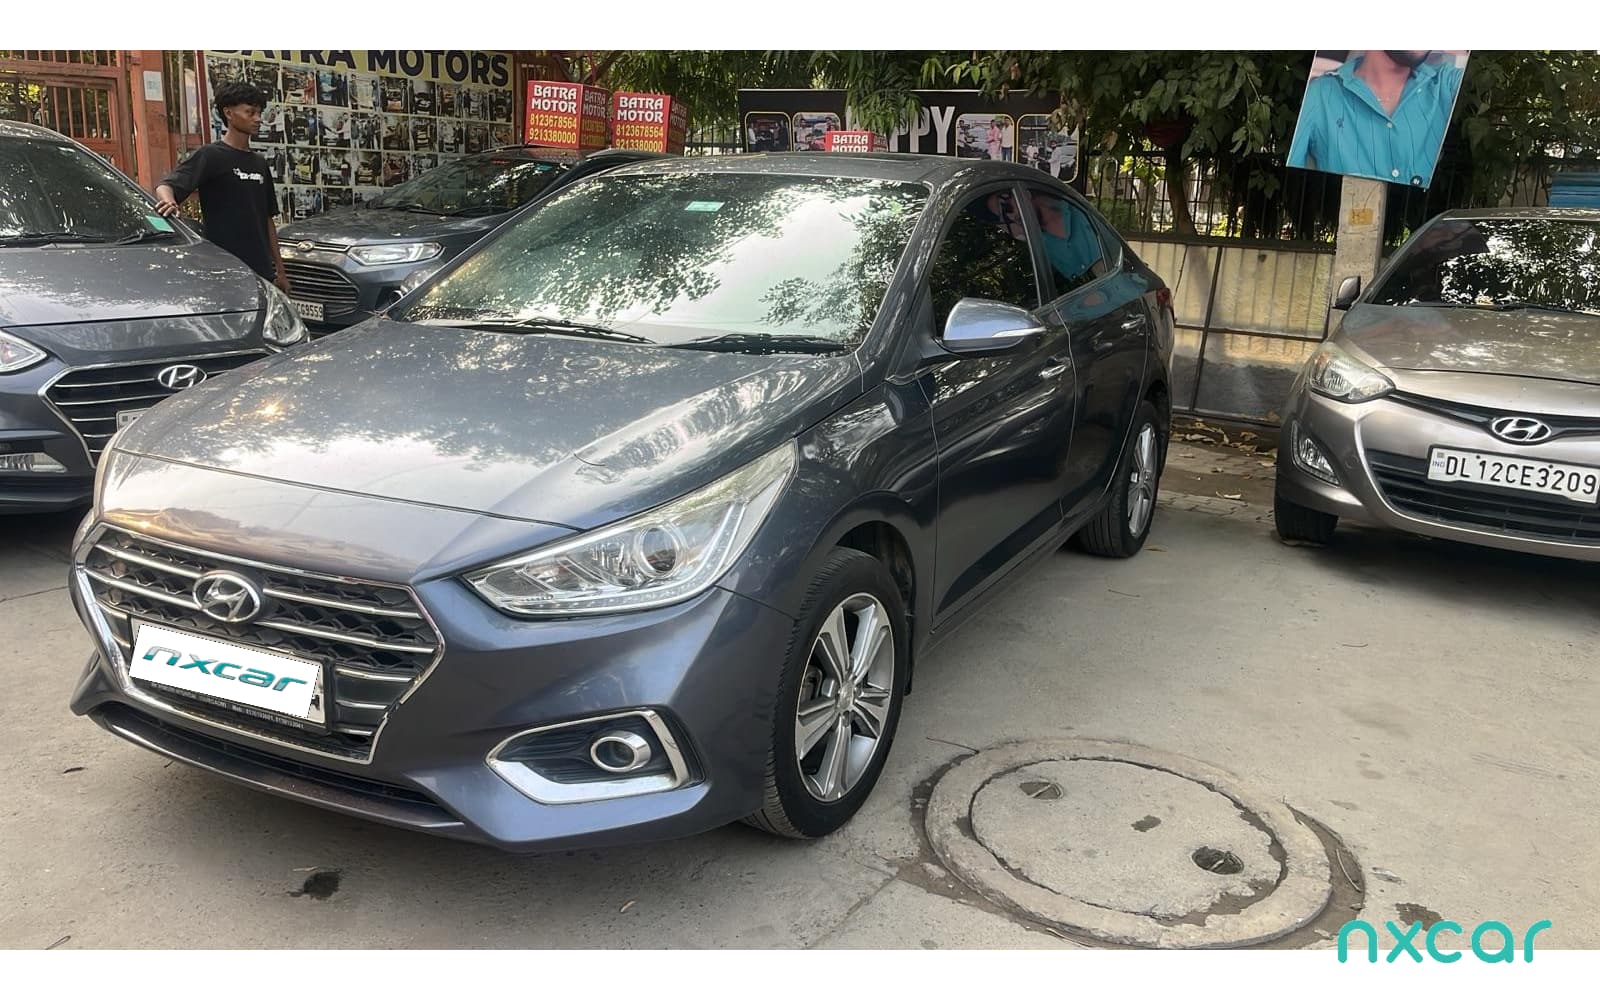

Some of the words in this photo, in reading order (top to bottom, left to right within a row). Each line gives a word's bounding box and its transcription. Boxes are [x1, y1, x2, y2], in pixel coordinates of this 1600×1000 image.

[368, 50, 509, 88] MOTORS
[533, 84, 577, 100] BATRA
[531, 98, 577, 114] MOTOR
[619, 96, 664, 110] BATRA
[530, 113, 577, 130] 8123678564
[617, 109, 664, 124] MOTOR
[529, 127, 577, 145] 9213380000
[616, 124, 664, 138] 8123678564
[832, 134, 869, 145] BATRA
[1446, 455, 1597, 495] DL12CE3209
